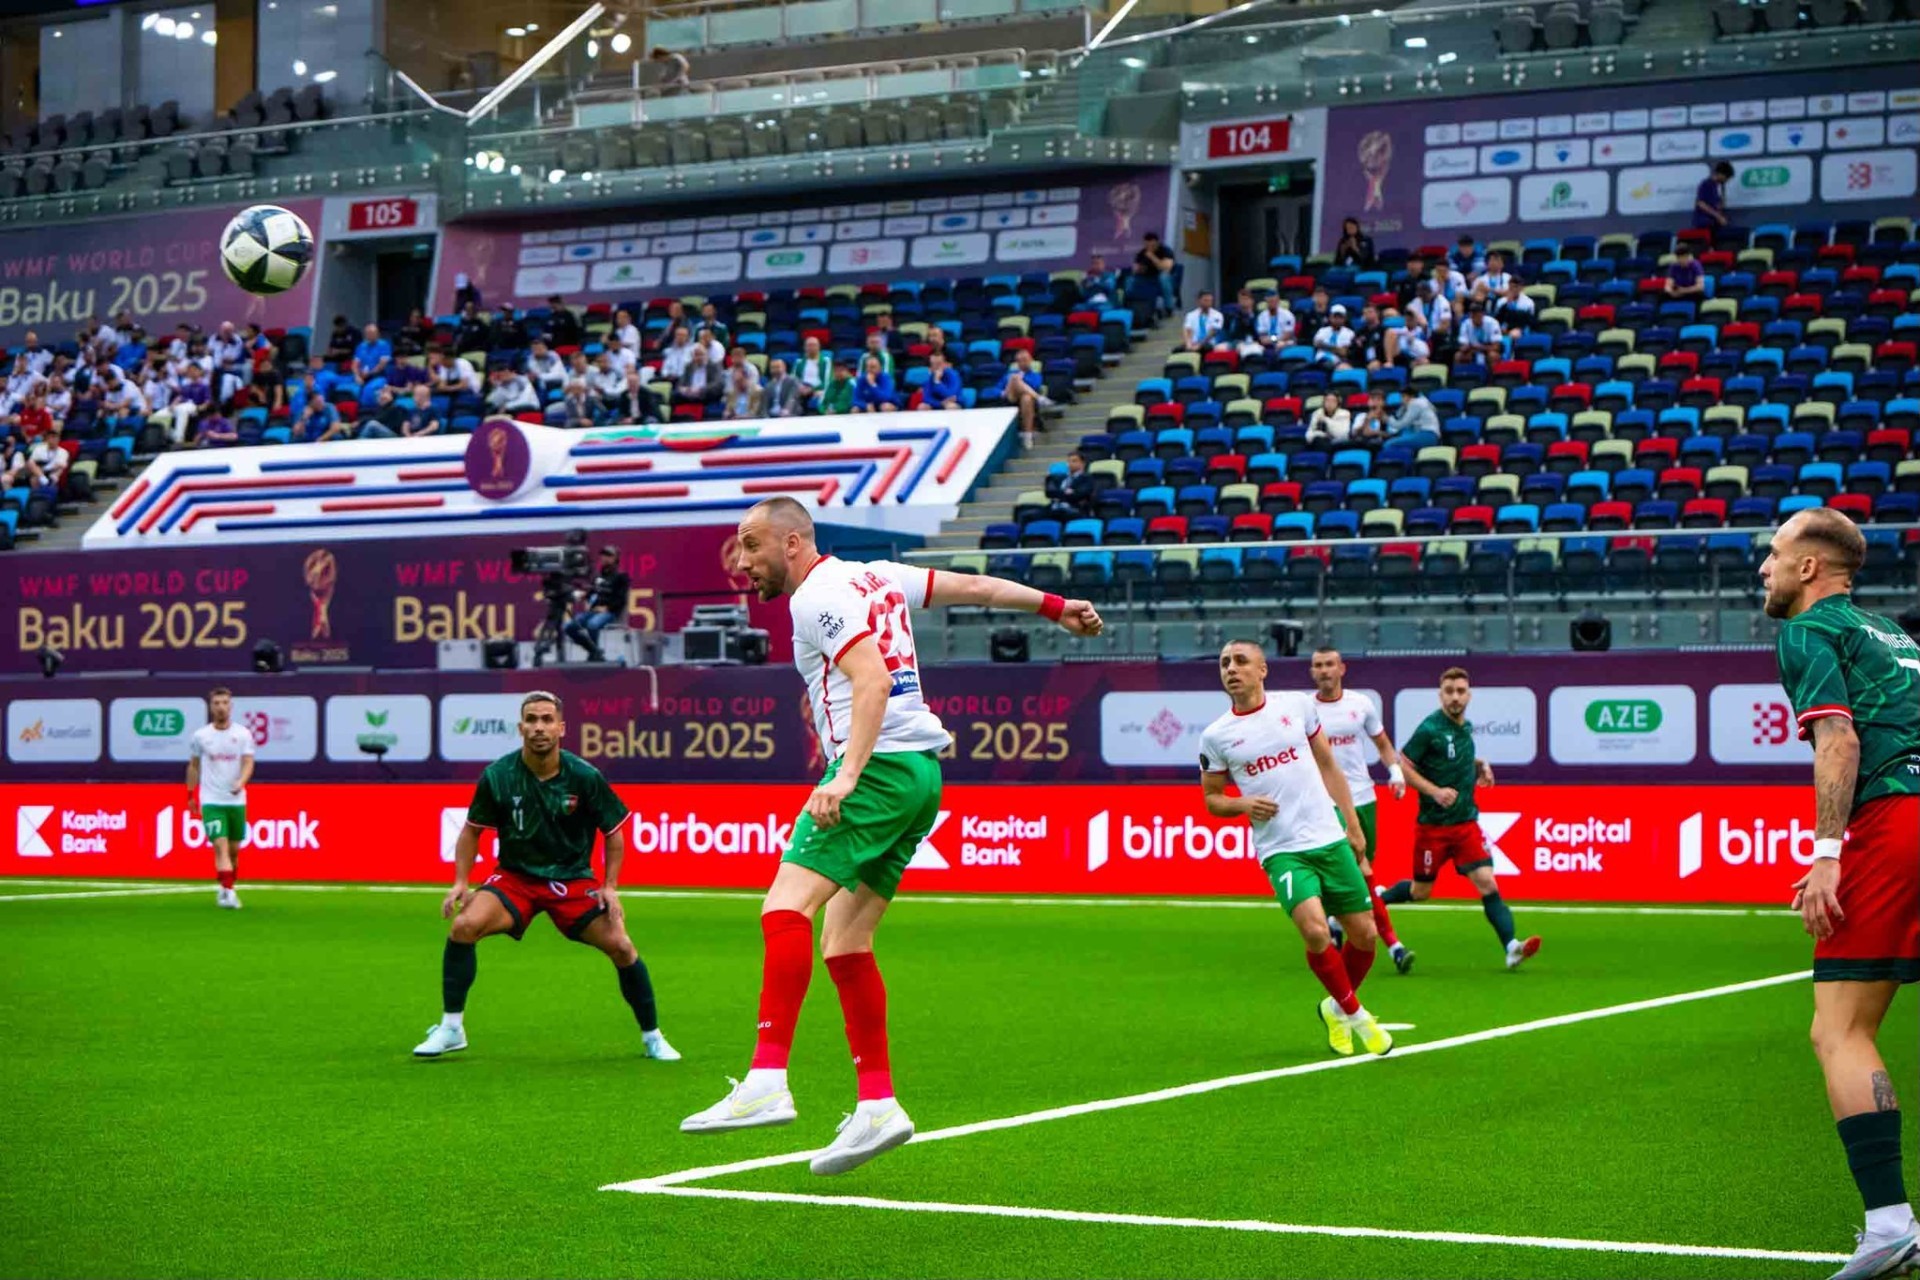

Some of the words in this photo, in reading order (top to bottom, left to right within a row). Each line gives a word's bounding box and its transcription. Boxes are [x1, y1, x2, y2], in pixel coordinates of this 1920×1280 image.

[1227, 125, 1271, 153] 104
[365, 202, 402, 226] 105
[4, 255, 58, 278] WMF
[68, 249, 155, 272] WORLD
[166, 241, 214, 263] CUP
[0, 280, 95, 326] Baku
[107, 270, 209, 317] 2025
[19, 575, 79, 598] WMF
[90, 571, 186, 596] WORLD
[195, 568, 249, 594] CUP
[396, 562, 465, 586] WMF
[19, 602, 125, 651] Baku
[139, 601, 248, 648] 2025
[395, 590, 516, 643] Baku
[825, 617, 846, 640] WMF
[582, 697, 632, 716] WMF
[642, 697, 723, 716] WORLD
[731, 697, 776, 715] CUP
[926, 696, 1013, 716] WORLD
[1021, 696, 1072, 717] CUP
[1597, 704, 1649, 728] AZE
[141, 713, 176, 732] AZE
[1472, 719, 1521, 736] erGold
[580, 720, 671, 760] Baku
[684, 721, 775, 760] 2025
[970, 721, 1070, 761] 2025
[1245, 746, 1299, 777] efbet
[61, 808, 127, 834] Kapital
[182, 810, 320, 849] bank
[632, 811, 795, 854] birbank
[961, 814, 1047, 842] Kapital
[1533, 817, 1631, 846] Kapital
[61, 834, 107, 853] Bank
[961, 843, 1021, 866] Bank
[1718, 817, 1816, 866] birb
[1533, 847, 1603, 871] Bank
